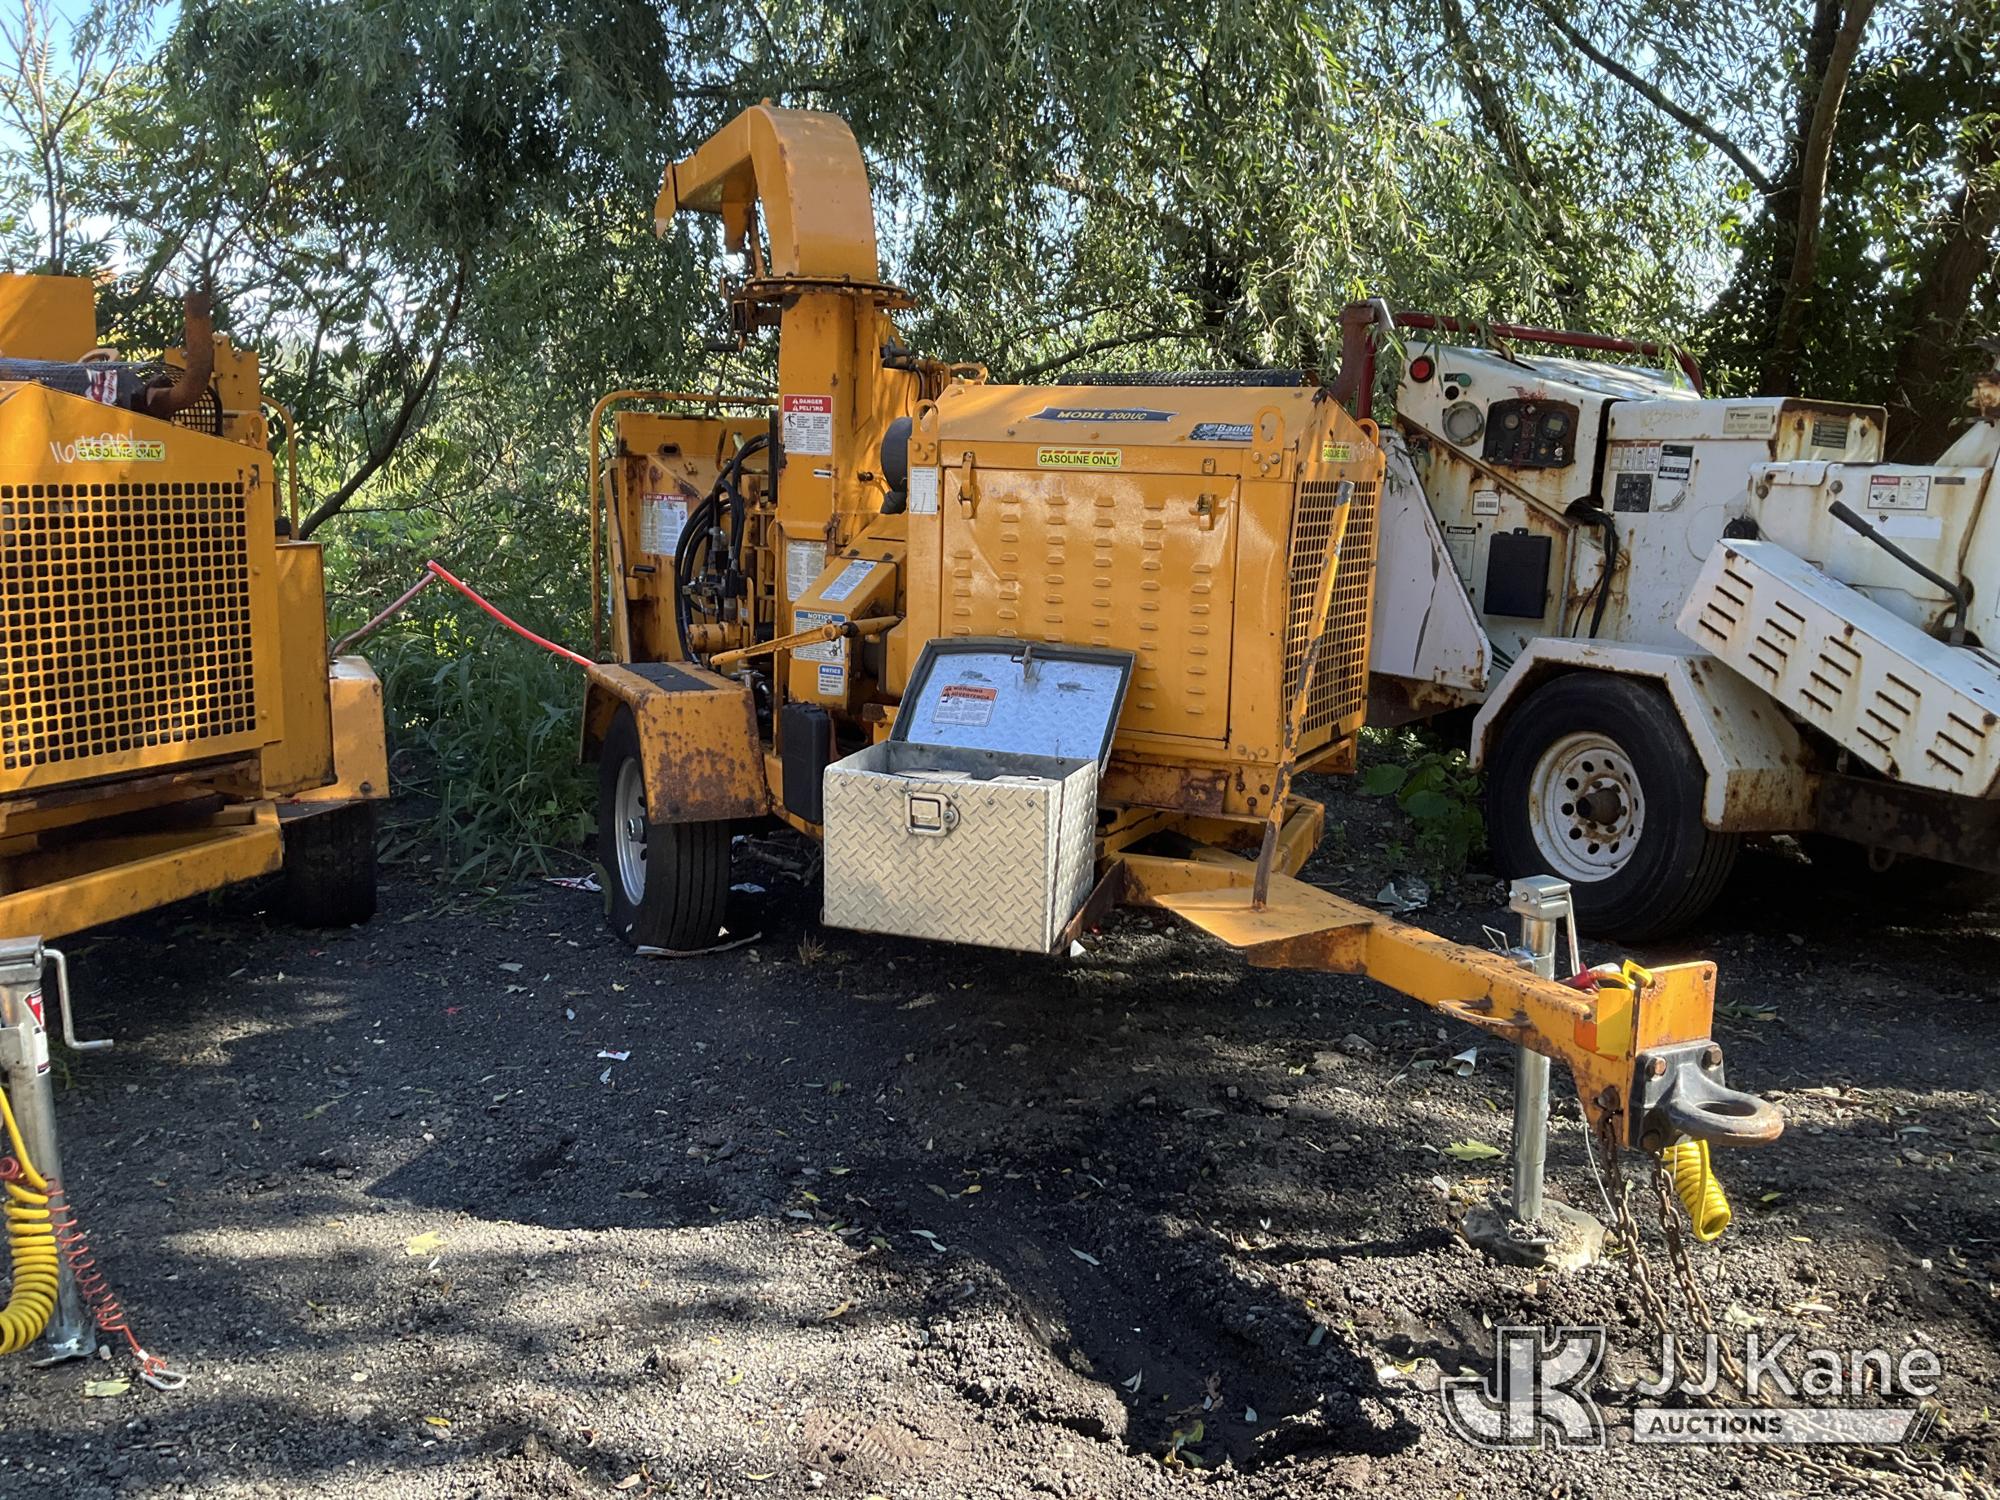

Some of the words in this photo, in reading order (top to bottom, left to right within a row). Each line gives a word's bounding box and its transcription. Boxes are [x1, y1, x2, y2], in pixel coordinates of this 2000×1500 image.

[1057, 410, 1105, 419] MODEL
[1107, 412, 1147, 420] 200UC
[1217, 424, 1254, 432] Bandi
[135, 448, 162, 458] ONLY
[1040, 454, 1089, 464] GASOLINE
[1091, 456, 1119, 465] ONLY
